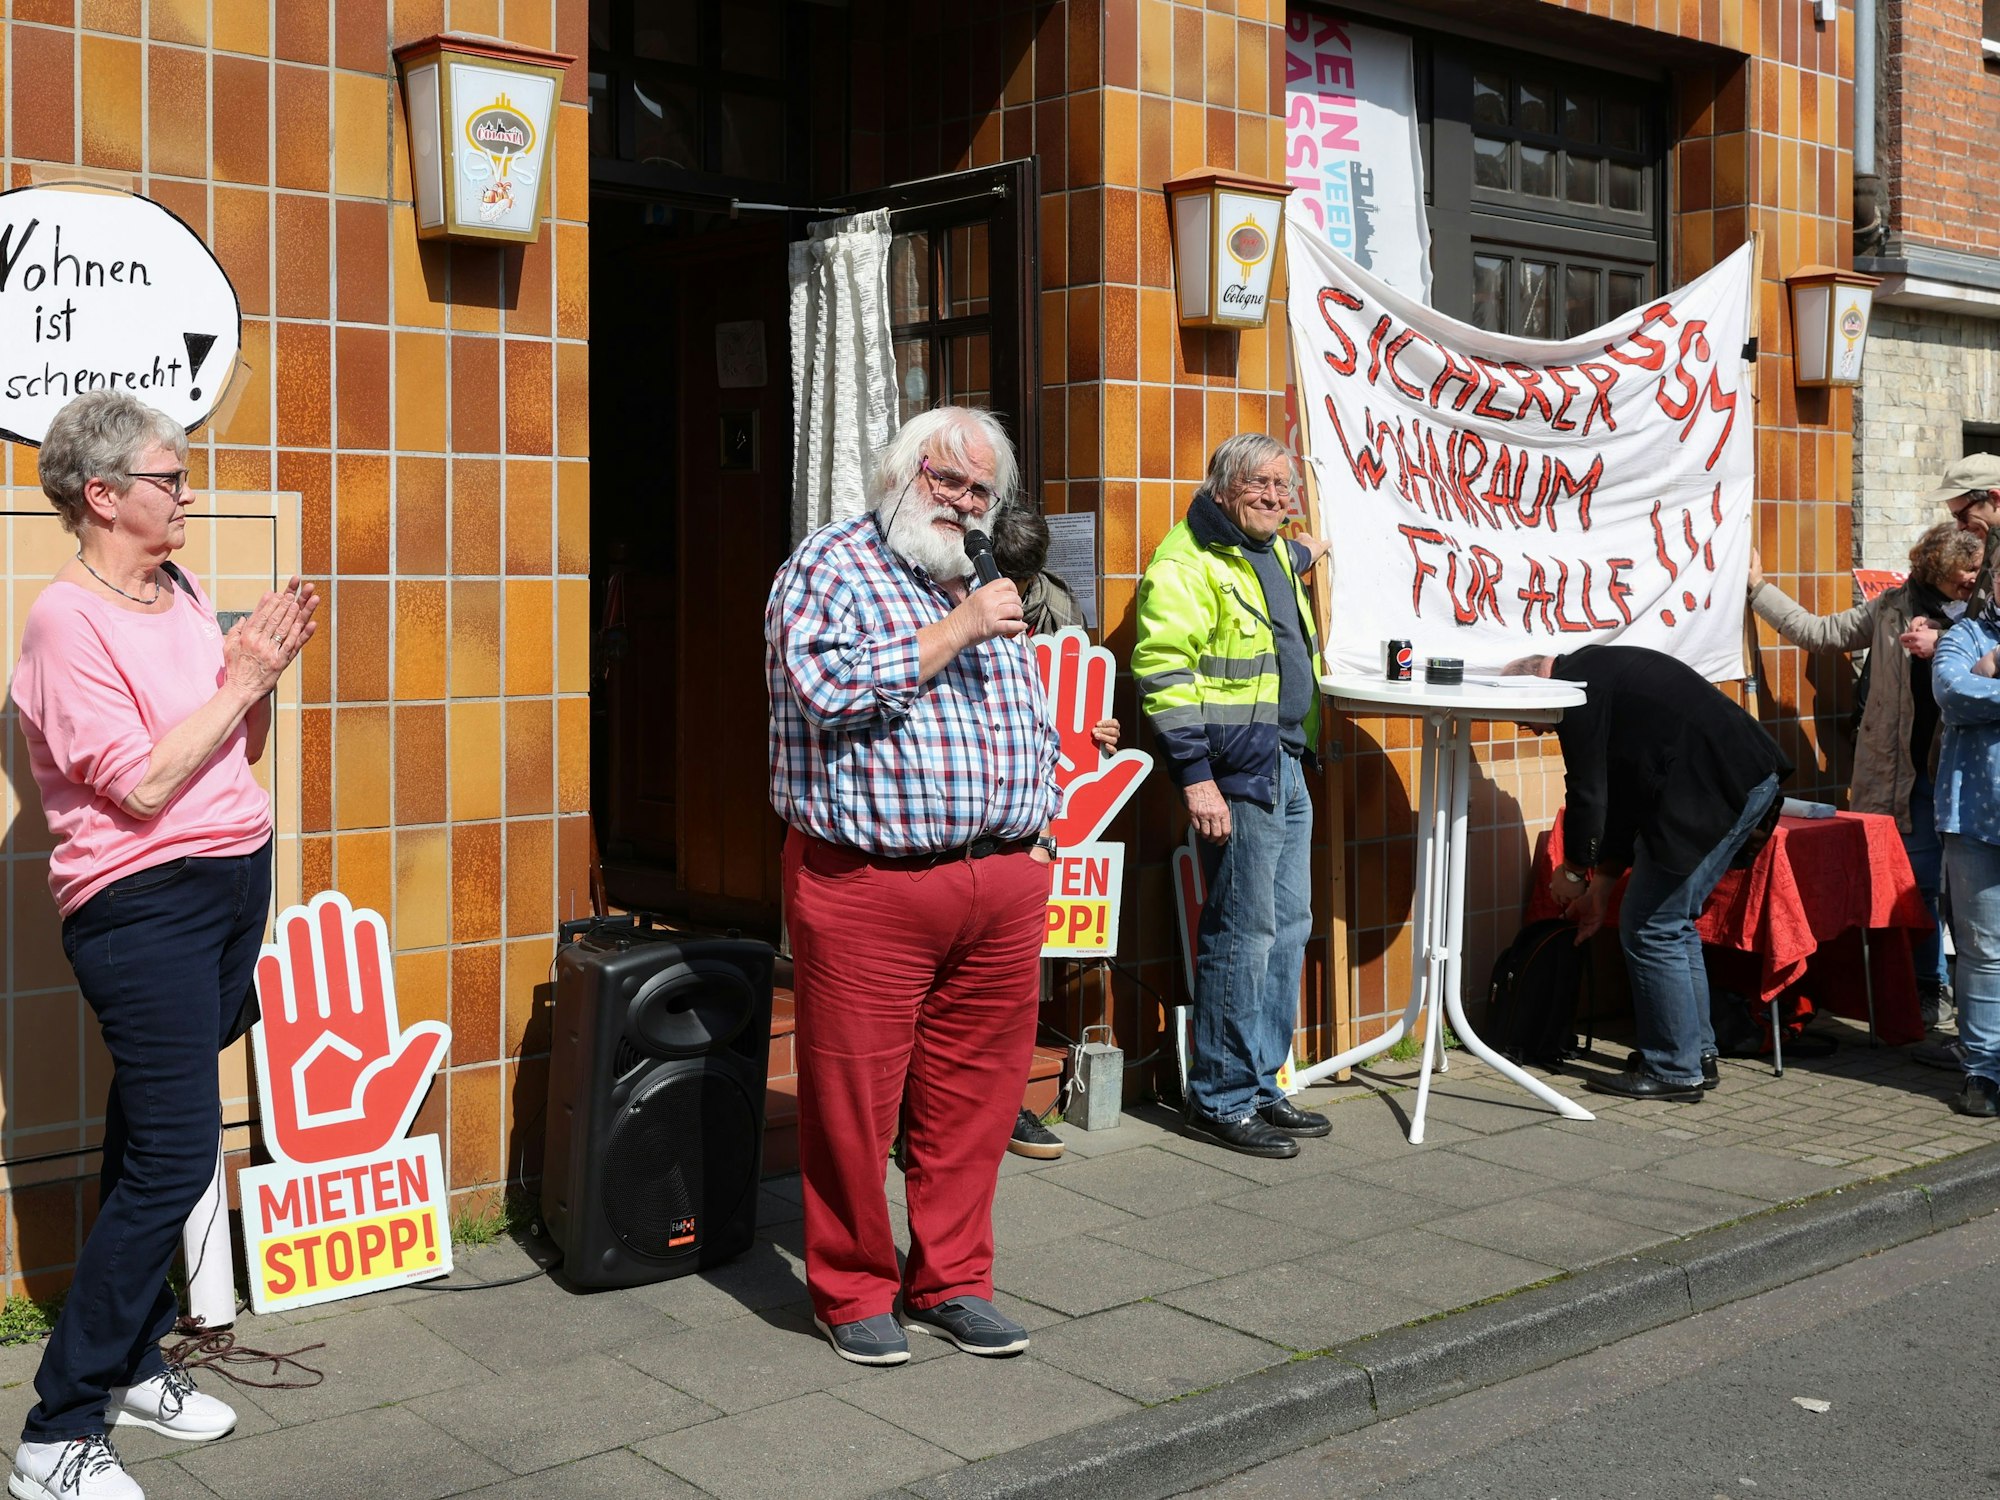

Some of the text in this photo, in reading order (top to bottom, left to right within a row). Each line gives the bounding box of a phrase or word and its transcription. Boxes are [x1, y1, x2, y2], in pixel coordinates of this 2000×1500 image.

[1312, 13, 1360, 152] KEIN
[1323, 159, 1352, 263] VEED
[36, 298, 76, 342] ist
[1223, 284, 1264, 310] Cologne
[1317, 286, 1619, 437] SICHERER
[1325, 393, 1604, 533] WOHNRAUM
[1398, 523, 1508, 628] FÜR
[1518, 553, 1634, 635] ALLE
[258, 1154, 430, 1235] MIETEN
[265, 1213, 436, 1295] STOPP!
